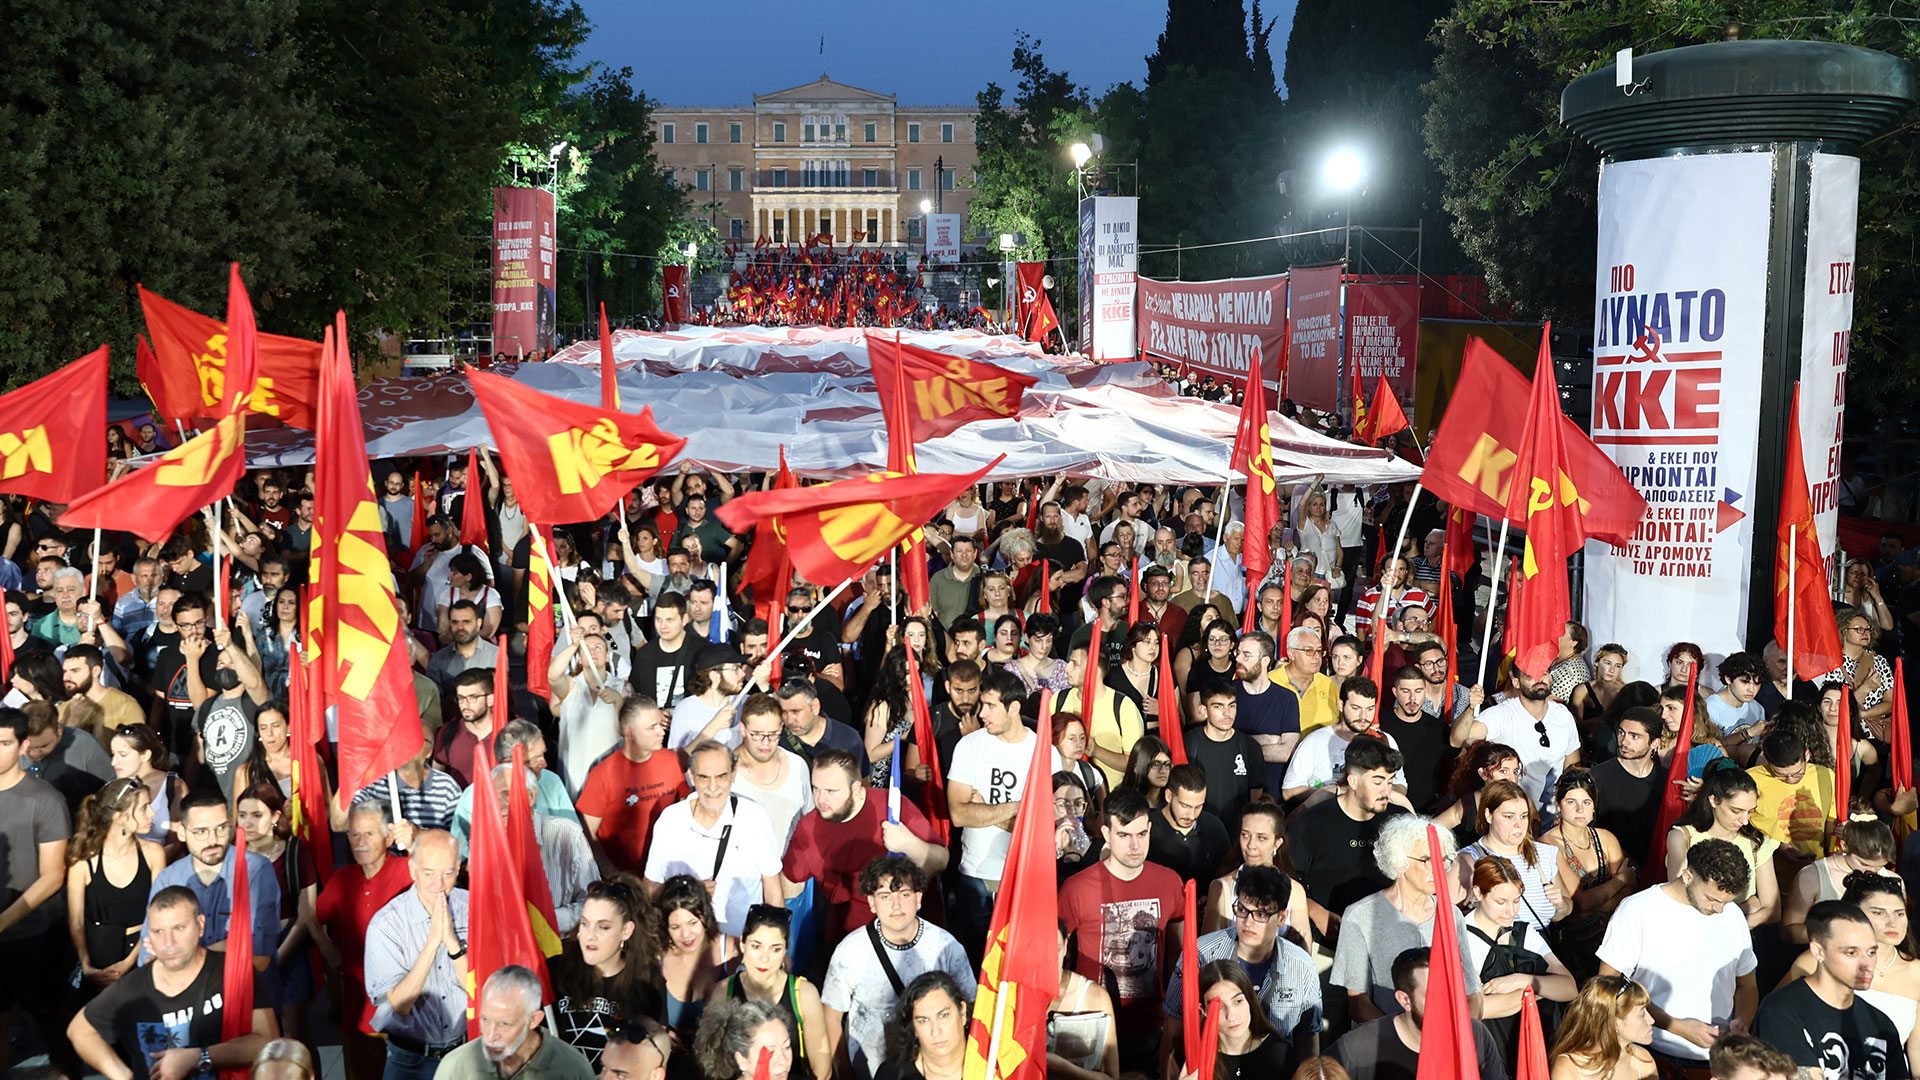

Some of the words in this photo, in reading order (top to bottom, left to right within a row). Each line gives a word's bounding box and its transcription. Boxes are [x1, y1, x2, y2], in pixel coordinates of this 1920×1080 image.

[1103, 223, 1111, 234] ΤΟ
[1112, 221, 1131, 234] ΔΙΚΙΟ
[1098, 245, 1106, 256] ΟΙ
[1107, 243, 1135, 255] ΑΝΑΓΚΕΣ
[1108, 255, 1125, 268] ΜΑΣ
[1611, 264, 1634, 293] ΠΙΟ
[1829, 262, 1851, 294] ΣΤΙΣ
[1110, 286, 1131, 296] ΔΥΝΑΤΟ
[1101, 305, 1131, 320] ΚΚΕ
[1183, 293, 1215, 322] ΚΑΡΔΙΑ
[1219, 292, 1233, 323] ΜΕ
[1234, 289, 1273, 325] ΜΥΑΛΟ
[1352, 315, 1368, 326] ΣΤΗΝ
[1369, 315, 1377, 326] ΕΕ
[1378, 315, 1389, 326] ΤΗΣ
[1598, 288, 1726, 347] ΔΥΝΑΤΟ
[1352, 326, 1396, 337] ΒΑΡΒΑΡΟΤΗΤΑΣ
[1150, 320, 1167, 353] ΓΙΑ
[1166, 324, 1187, 357] ΚΚΕ
[1187, 329, 1209, 364] ΠΙΟ
[1211, 331, 1264, 372] ΔΥΝΑΤΟ
[1301, 343, 1310, 359] ΤΟ
[1311, 341, 1326, 358] ΚΚΕ
[1384, 356, 1394, 367] ΜΕ
[1351, 366, 1383, 377] ΔΝΑΤΟ
[1384, 366, 1401, 377] ΚΚΕ
[912, 375, 1008, 420] ΚΚΕ
[1593, 368, 1722, 431] ΚΚΕ
[1648, 452, 1656, 465] &
[1660, 451, 1687, 465] ΕΚΕΙ
[1692, 451, 1718, 465] ΠΟΥ
[1644, 489, 1716, 503] ΑΠΟΦΑΣΕΙΣ
[1646, 507, 1653, 519] &
[1657, 507, 1685, 520] ΕΚΕΙ
[1689, 507, 1715, 521] ΠΟΥ
[1645, 546, 1712, 561] ΔΡΟΜΟΥΣ
[1633, 560, 1655, 576] ΤΟΥ
[1659, 562, 1712, 578] ΑΓΩΝΑ!
[990, 767, 1018, 790] BO
